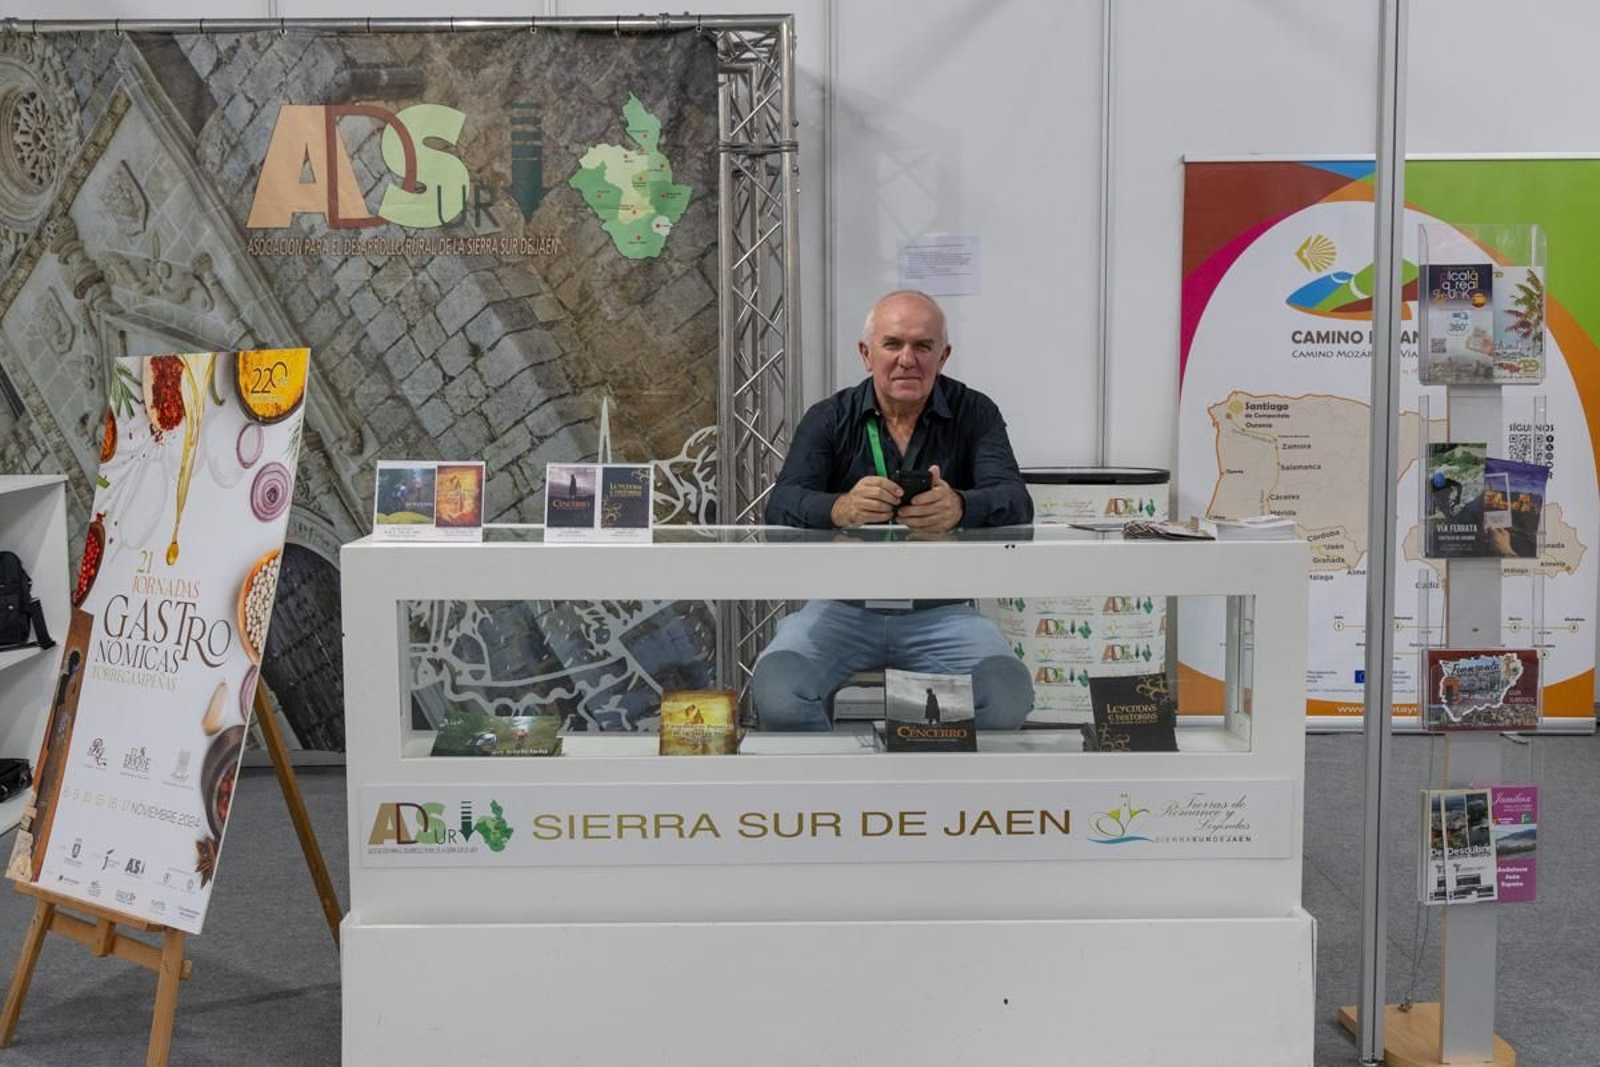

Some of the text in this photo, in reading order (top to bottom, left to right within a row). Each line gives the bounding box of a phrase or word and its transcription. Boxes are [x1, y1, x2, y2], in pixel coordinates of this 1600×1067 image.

[304, 238, 328, 256] PARA
[331, 238, 341, 256] EL
[345, 238, 404, 256] DESARROLLO
[406, 237, 436, 256] RURAL
[439, 237, 450, 256] DE
[453, 237, 464, 255] LA
[467, 237, 498, 255] SIERRA
[500, 237, 518, 255] SUR
[520, 237, 535, 255] DE
[1291, 330, 1364, 345] CAMINO
[1291, 350, 1333, 358] CAMINO
[1245, 402, 1289, 412] Santiago
[1269, 493, 1300, 501] Cáceres
[1450, 523, 1478, 532] FERRATA
[1307, 530, 1340, 542] Córdoba
[136, 550, 153, 574] 21
[131, 575, 200, 599] JORNADAS
[103, 594, 231, 668] GASTRO
[1231, 794, 1247, 808] de
[130, 801, 178, 824] NOVIEMBRE
[177, 812, 201, 829] 2024
[532, 809, 1071, 841] SIERRA SUR DE JAEN
